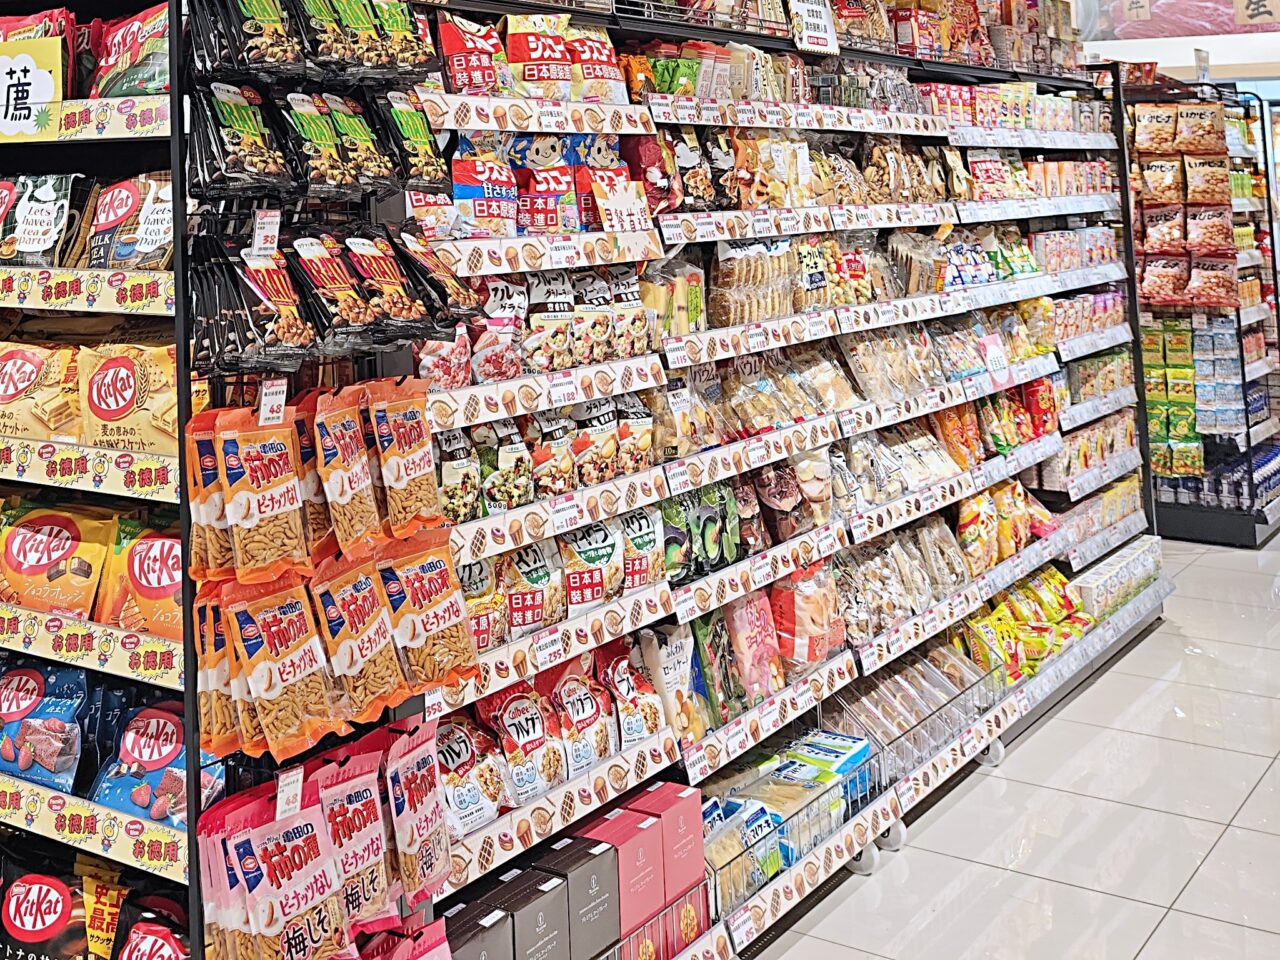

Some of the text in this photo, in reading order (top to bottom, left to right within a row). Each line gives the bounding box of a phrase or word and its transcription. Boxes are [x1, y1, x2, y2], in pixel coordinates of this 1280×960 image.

[96, 368, 132, 408] KitKat
[269, 405, 282, 415] 48
[124, 467, 169, 488] お徳用
[14, 525, 71, 564] KitKat
[570, 570, 602, 586] 日本原
[512, 593, 543, 607] 日本原
[570, 586, 602, 603] 裝進口
[512, 610, 542, 625] 裝進口
[426, 701, 442, 716] 358
[260, 833, 320, 889] 柿の種
[13, 889, 62, 930] KitKat
